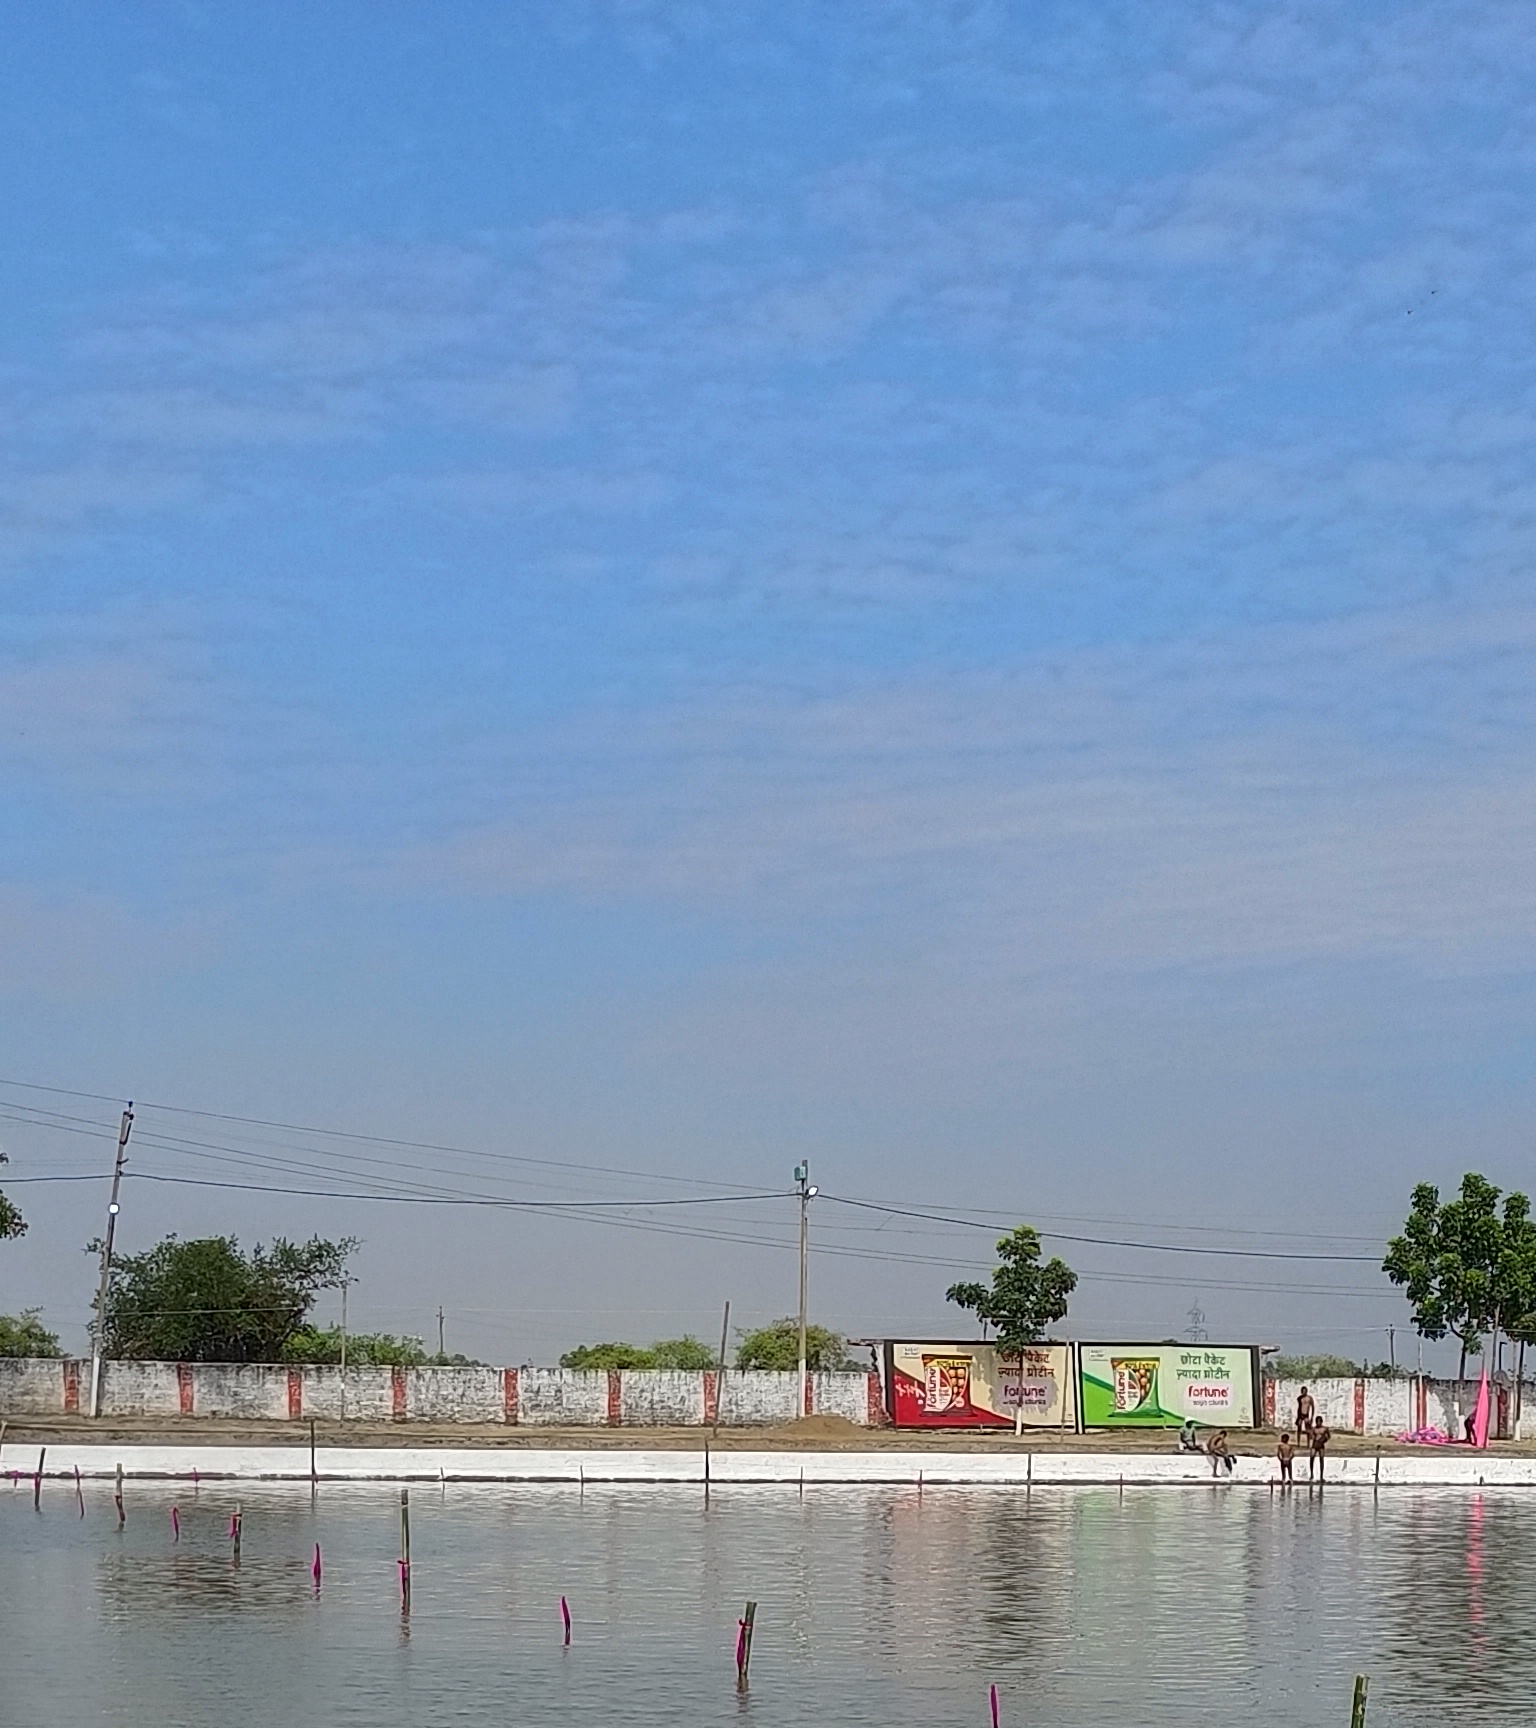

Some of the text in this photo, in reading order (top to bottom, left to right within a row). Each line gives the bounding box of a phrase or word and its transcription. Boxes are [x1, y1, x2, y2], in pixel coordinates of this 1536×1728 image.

[1180, 1352, 1226, 1366] छोटा पैकेट
[1026, 1364, 1055, 1378] प्रोटीन
[1203, 1366, 1231, 1379] प्रोटीन
[927, 1368, 937, 1408] fortune
[1117, 1371, 1127, 1410] fortune
[1188, 1385, 1228, 1398] fortune
